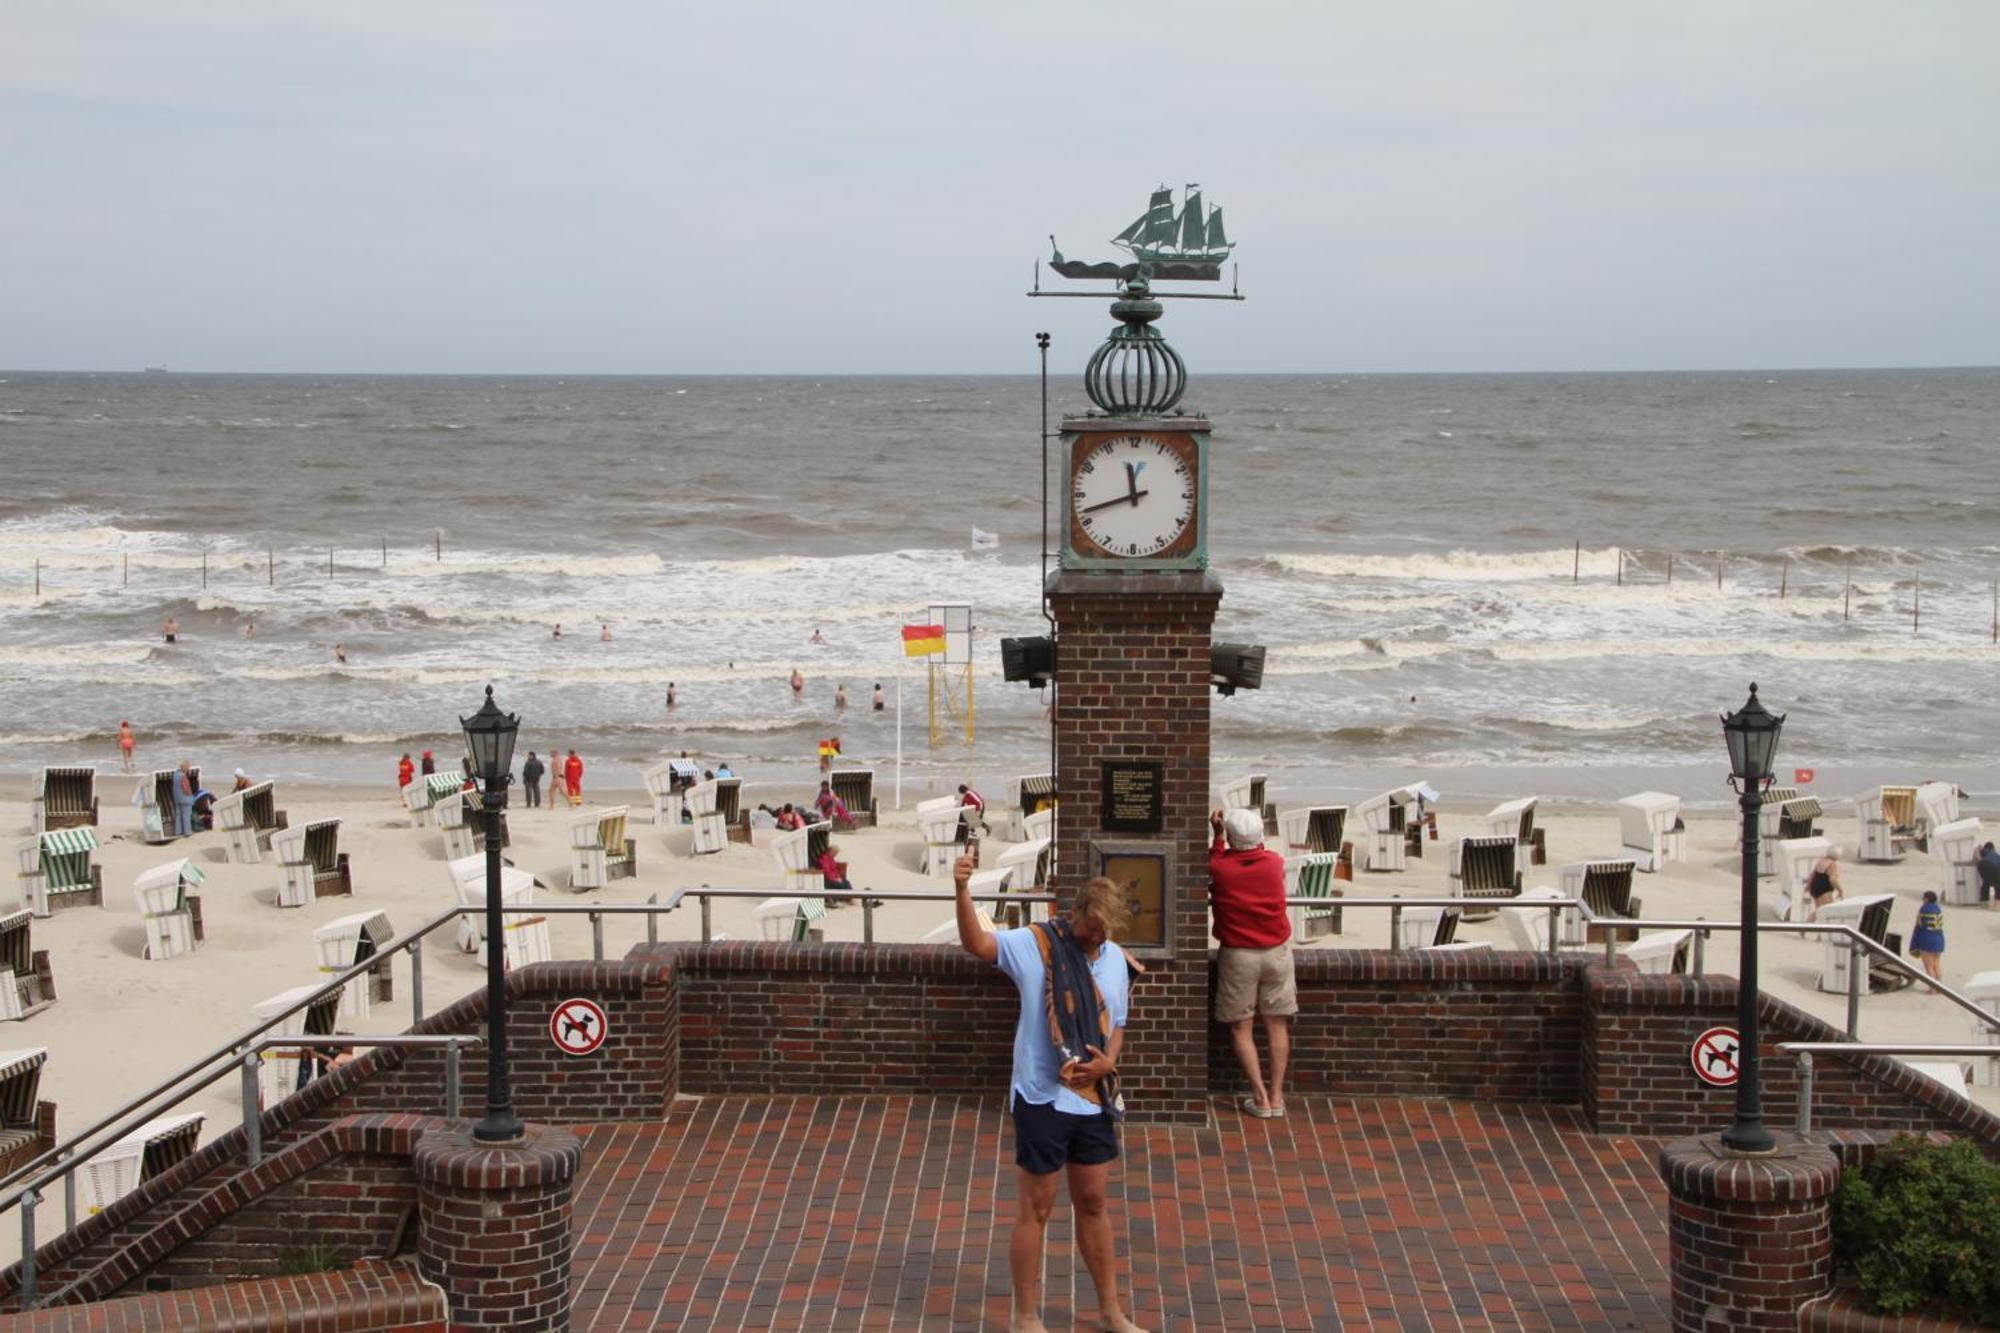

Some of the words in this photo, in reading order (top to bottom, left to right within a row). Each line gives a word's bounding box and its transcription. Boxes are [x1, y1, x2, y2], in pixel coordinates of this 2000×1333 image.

[1128, 437, 1141, 448] 12
[1103, 444, 1114, 454] 11
[1158, 445, 1165, 455] 1
[1082, 462, 1094, 474] 10
[1175, 465, 1186, 474] 2
[1083, 518, 1092, 526] 8
[1176, 518, 1185, 527] 4
[1102, 536, 1112, 545] 7
[1156, 536, 1165, 546] 5
[1130, 544, 1136, 555] 6
